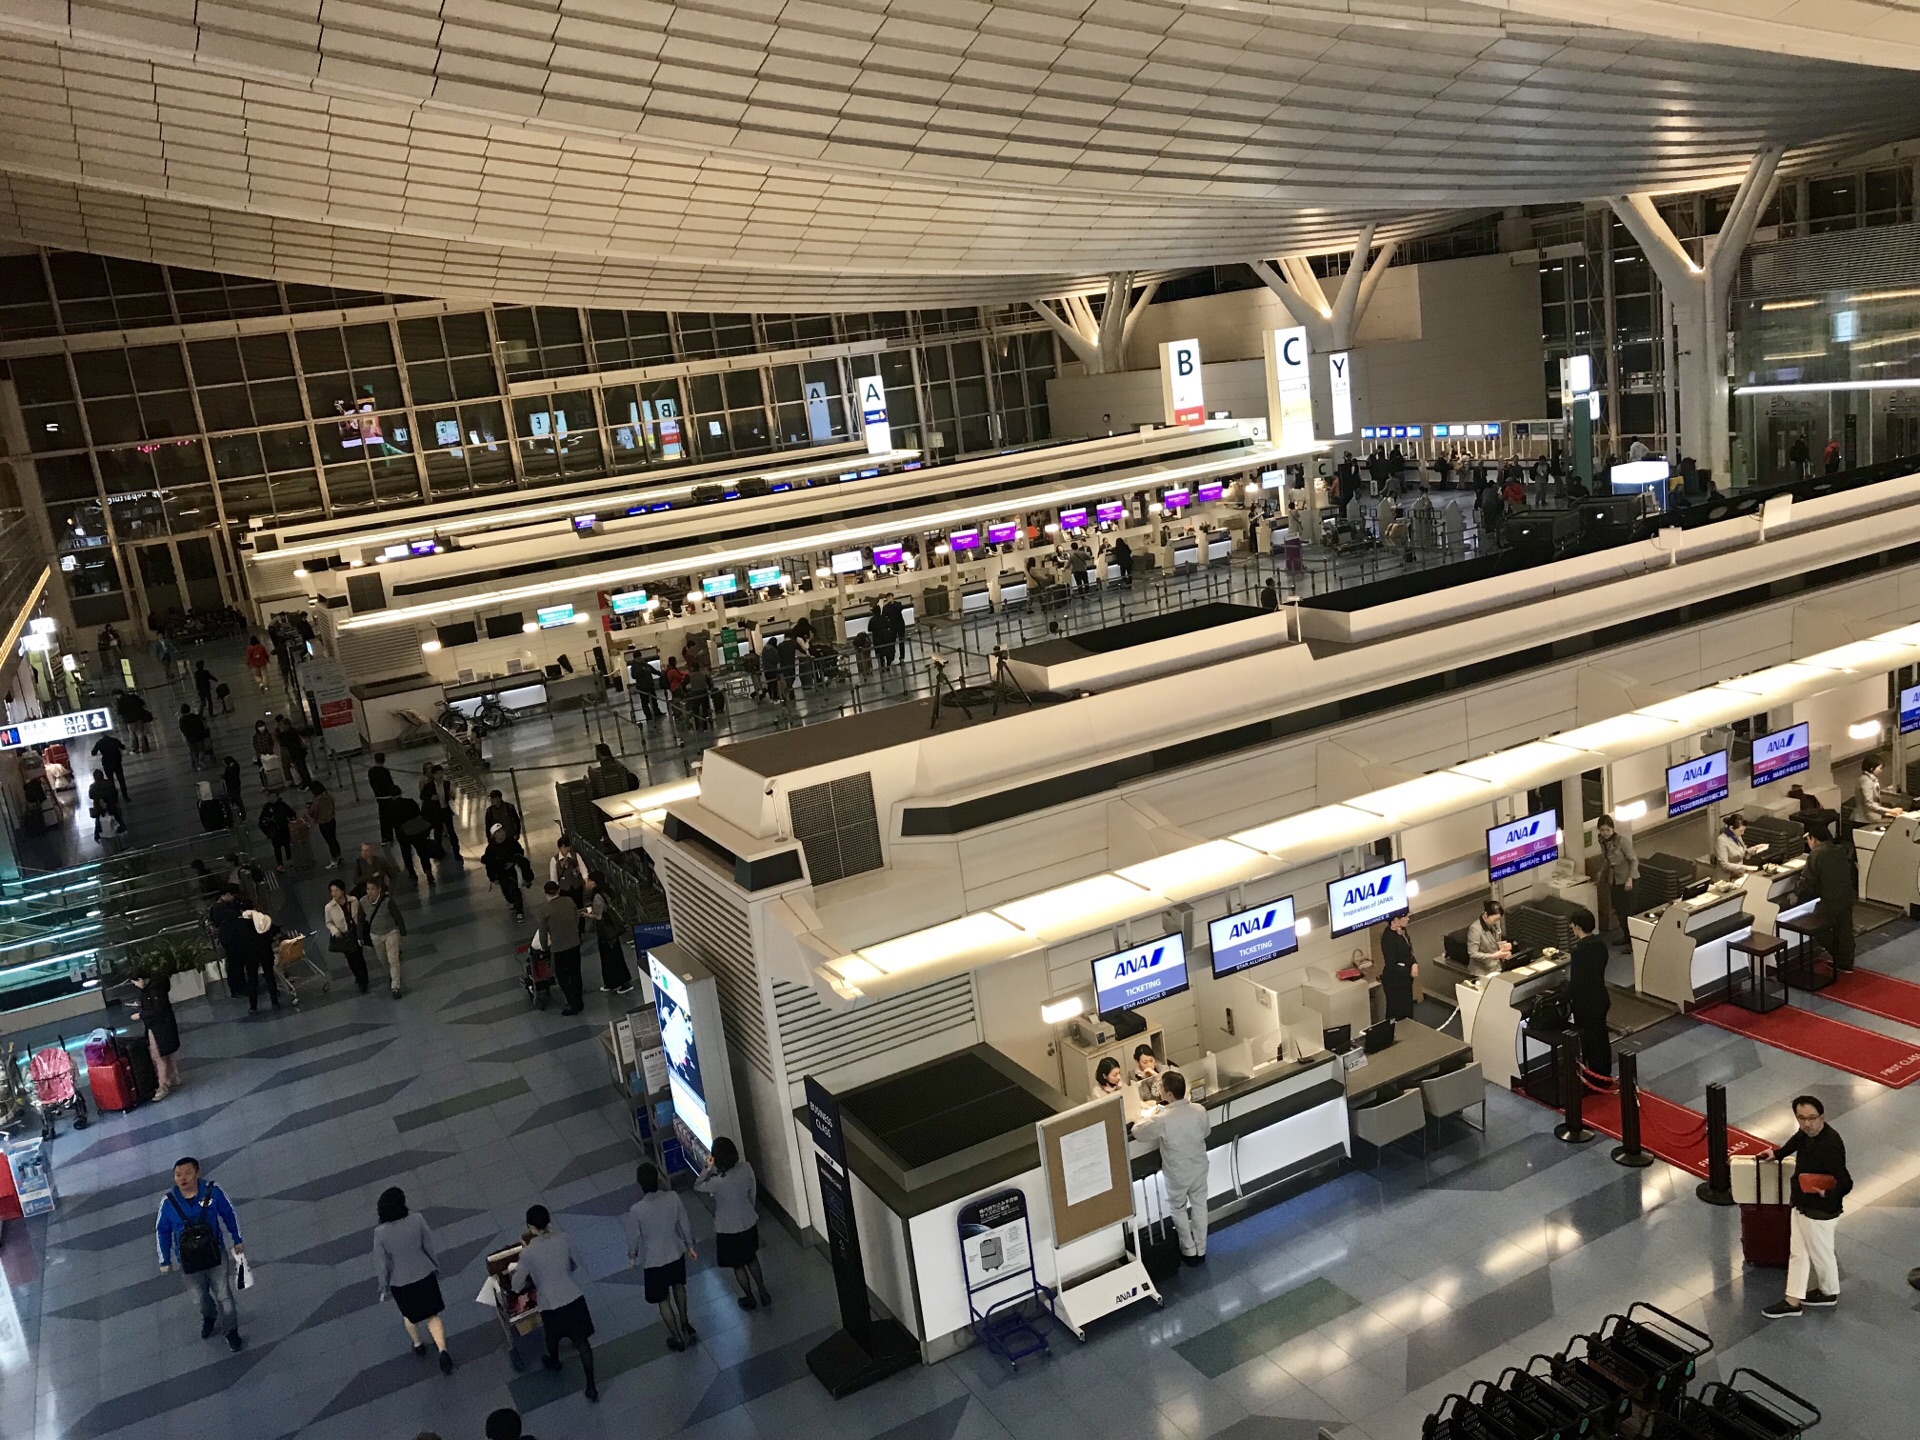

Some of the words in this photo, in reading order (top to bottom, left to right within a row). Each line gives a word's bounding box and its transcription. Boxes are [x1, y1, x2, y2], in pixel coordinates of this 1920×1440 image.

[1283, 337, 1301, 366] C
[1177, 349, 1193, 376] B
[1332, 358, 1345, 378] Y
[866, 383, 881, 402] A
[1318, 463, 1326, 475] C
[1766, 738, 1786, 754] ANA
[1682, 766, 1702, 783] ANA
[1505, 826, 1529, 844] ANA
[1343, 882, 1376, 907] ANA
[1343, 904, 1370, 917] Inspiration
[1377, 896, 1394, 906] JAPAN
[1229, 916, 1260, 940] ANA
[1351, 922, 1364, 930] STAR
[1364, 915, 1385, 926] ALLIANCE
[1239, 940, 1273, 957] TICKETING
[1114, 954, 1148, 980] ANA
[1236, 962, 1249, 970] STAR
[1249, 954, 1272, 965] ALLIANCE
[1125, 978, 1161, 997] TICKETING
[1122, 1001, 1137, 1011] STAR
[1136, 992, 1160, 1005] ALLIANCE
[1880, 1063, 1902, 1076] FIRST
[809, 1101, 833, 1128] BUSINESS
[815, 1119, 831, 1138] CLASS
[1115, 1291, 1131, 1304] ANA
